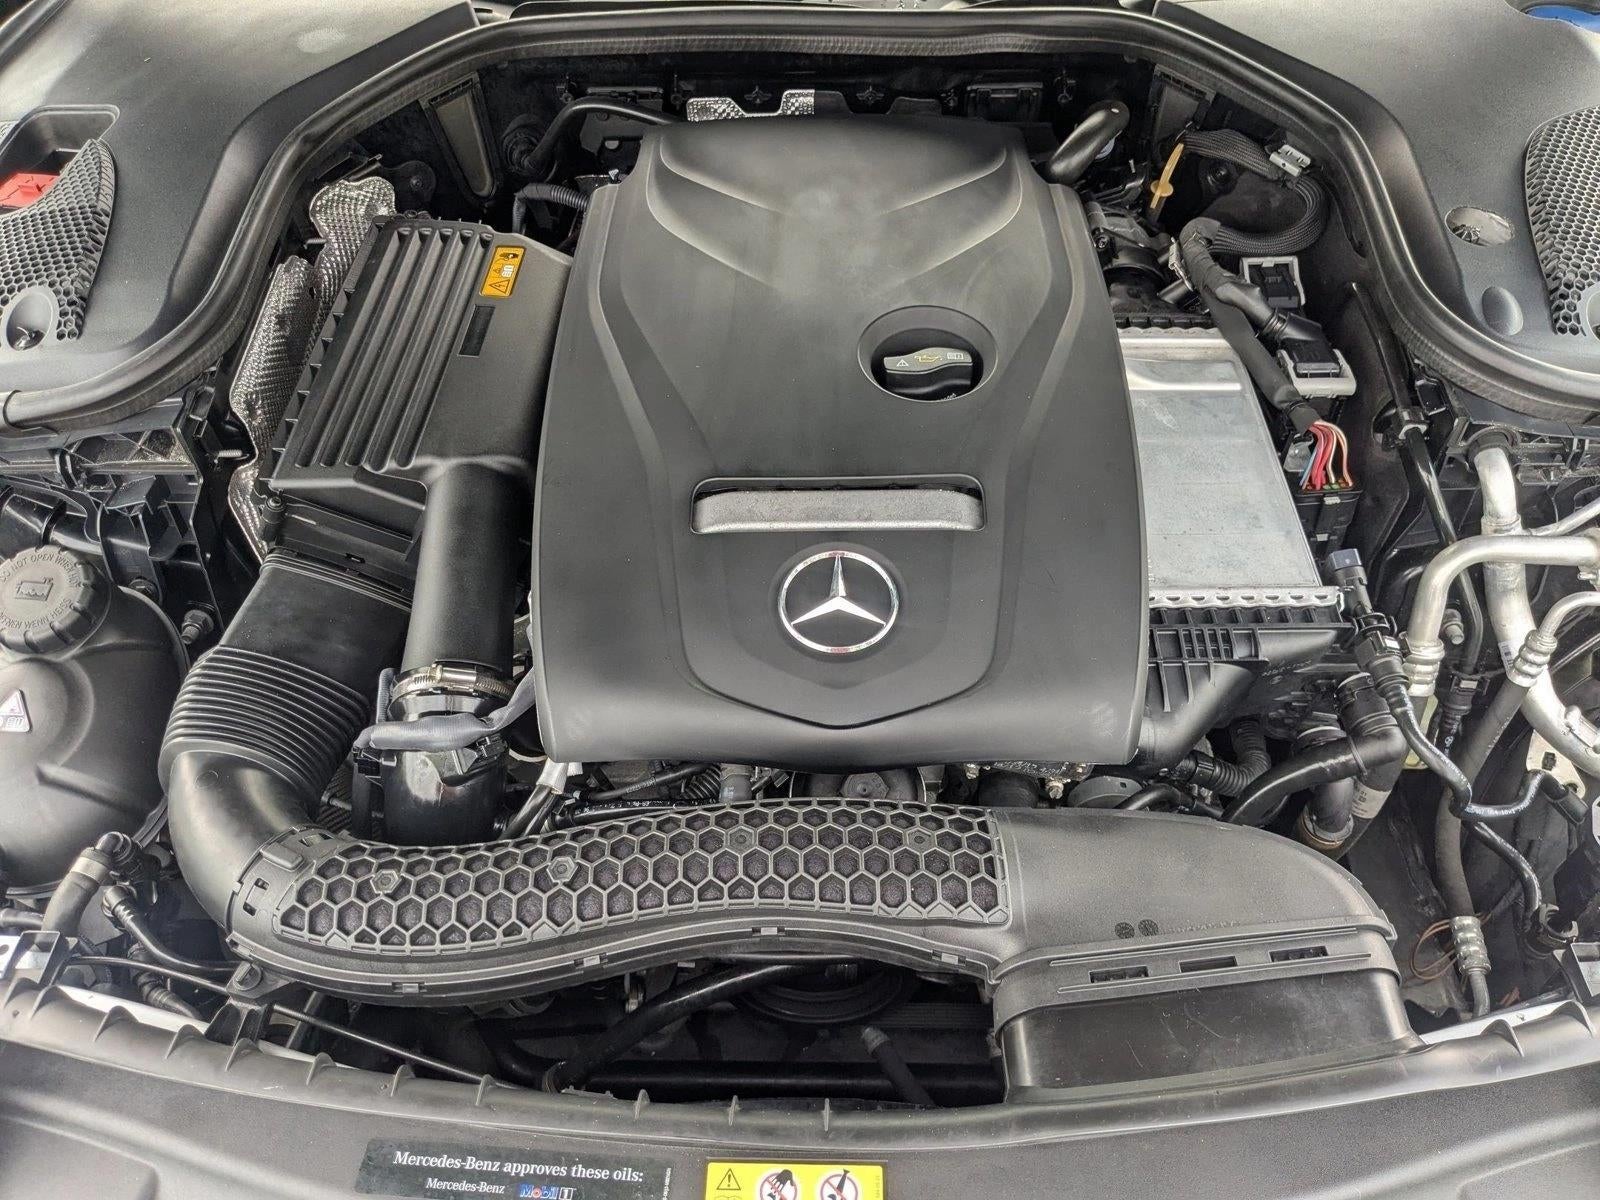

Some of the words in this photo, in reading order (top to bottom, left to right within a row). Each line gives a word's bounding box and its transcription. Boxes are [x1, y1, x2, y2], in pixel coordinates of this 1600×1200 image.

[11, 557, 27, 572] NOT
[30, 553, 54, 562] OPEN
[55, 555, 74, 575] WHEN
[392, 1151, 501, 1172] Mercedes-Benz
[503, 1161, 568, 1177] approves
[571, 1164, 610, 1180] these
[613, 1167, 644, 1182] oils:
[425, 1178, 507, 1194] Mercedes-Benz
[519, 1184, 559, 1200] Mobil
